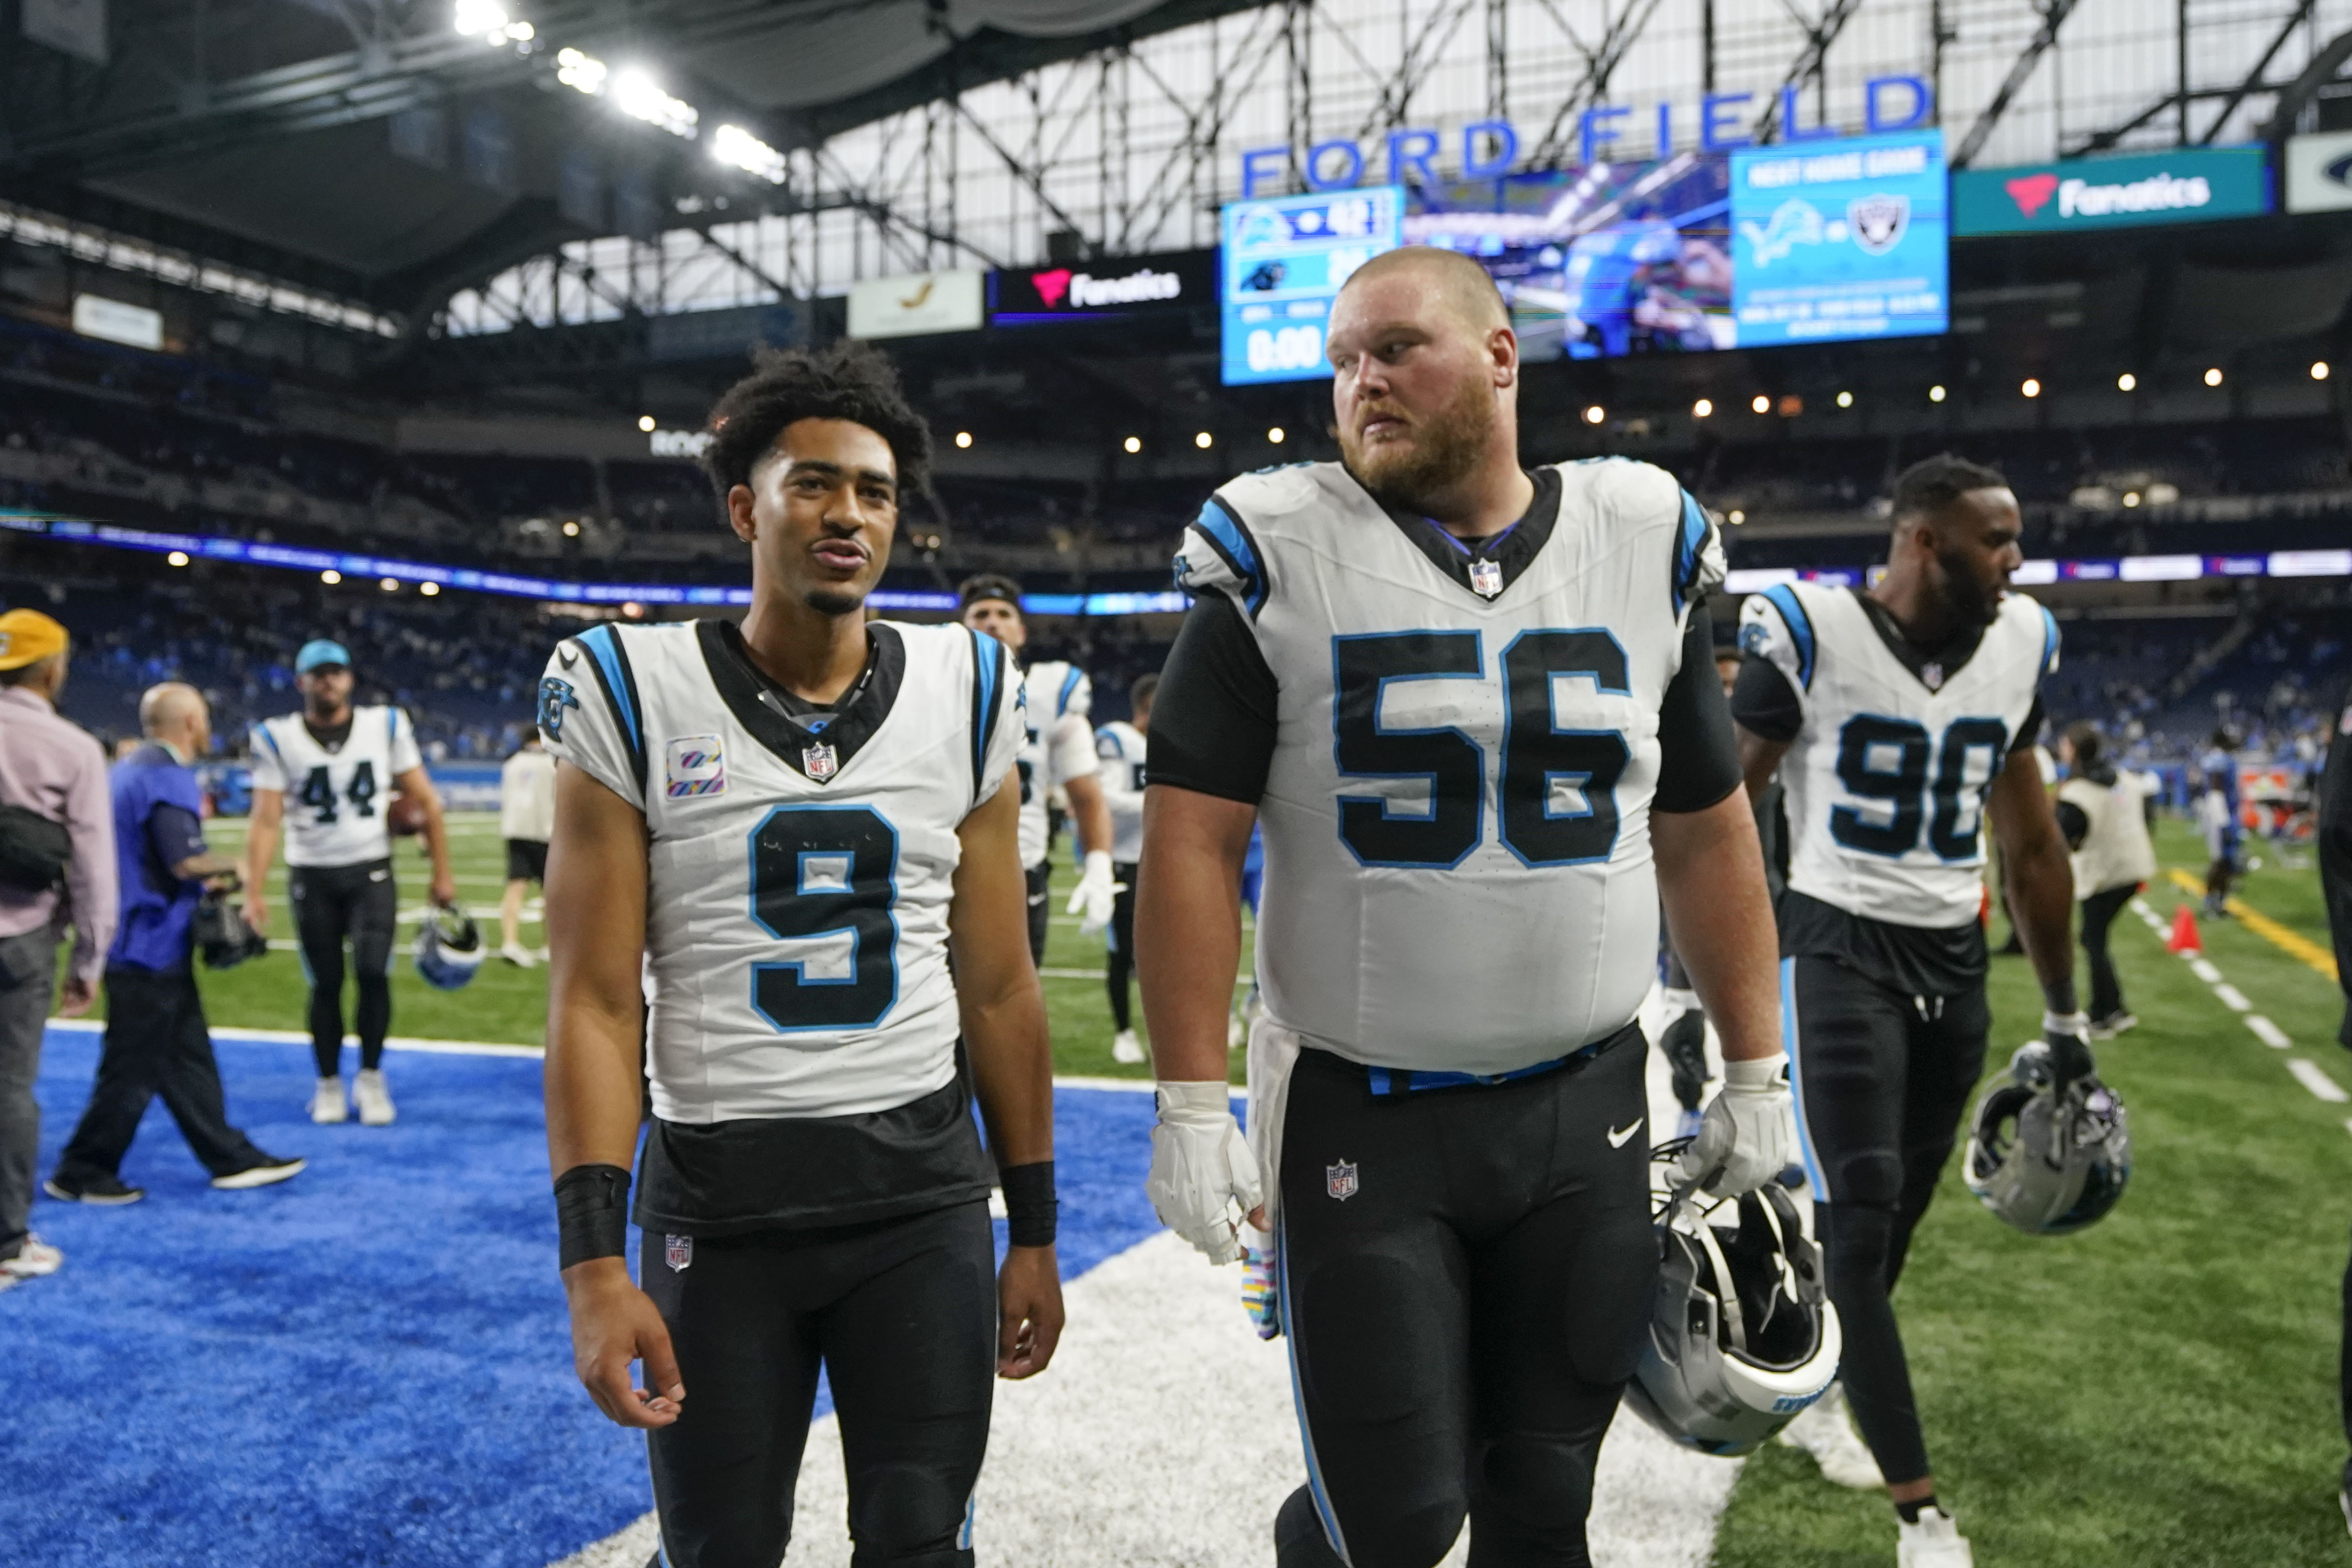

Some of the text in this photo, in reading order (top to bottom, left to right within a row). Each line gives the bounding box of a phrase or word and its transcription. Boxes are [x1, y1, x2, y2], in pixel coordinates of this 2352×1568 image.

[1242, 76, 1932, 197] FORD FIELD
[2057, 173, 2210, 218] Fanatics
[1070, 268, 1180, 307] Fanatics
[1247, 325, 1322, 373] 0:00
[810, 760, 833, 773] NFL
[1331, 627, 1633, 870] 56
[300, 760, 376, 823] 44
[1829, 713, 2008, 865] 90
[747, 804, 899, 1034] 9
[1332, 1178, 1351, 1192] NFL
[670, 1249, 688, 1263] NFL
